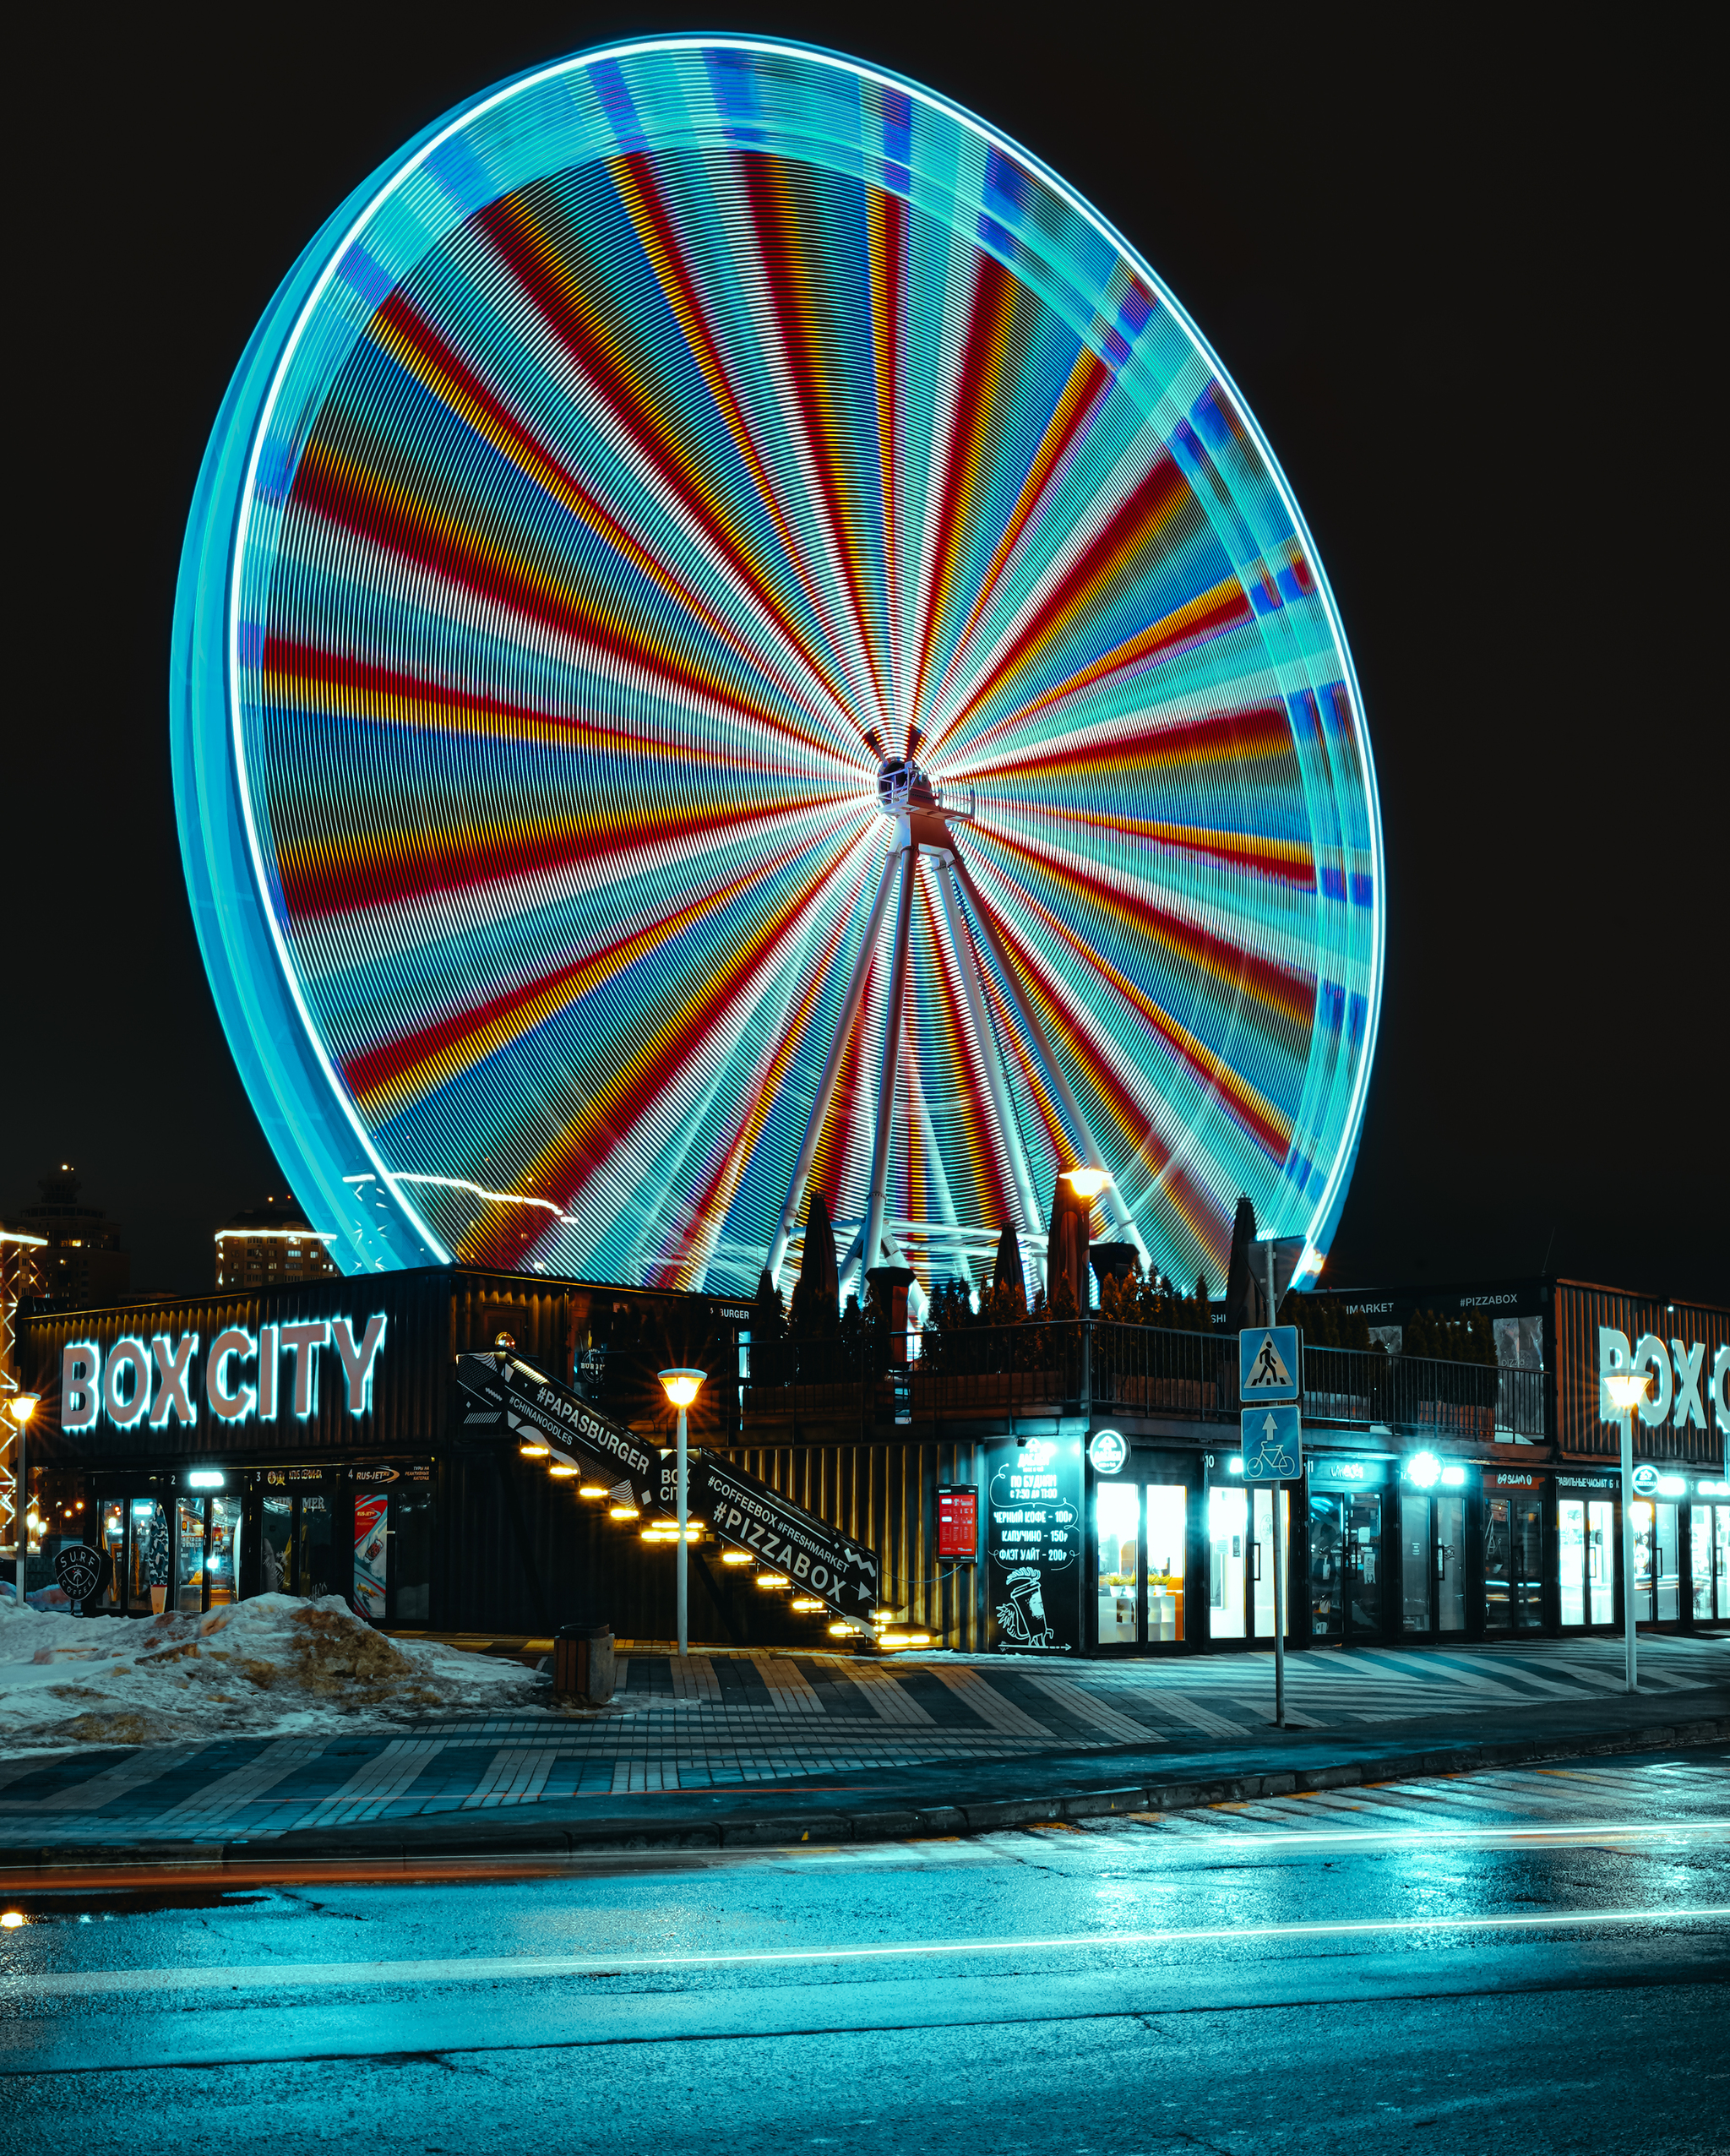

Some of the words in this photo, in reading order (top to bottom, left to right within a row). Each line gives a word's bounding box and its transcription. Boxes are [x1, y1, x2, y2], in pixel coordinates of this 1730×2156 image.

[1461, 1294, 1517, 1307] #PIZZABOX
[1346, 1303, 1394, 1315] MARKET
[63, 1335, 198, 1429] BOX
[206, 1315, 387, 1421] CITY
[509, 1395, 574, 1446] #CHINANOODLES
[537, 1386, 650, 1474] #PAPASBURGER
[1205, 1455, 1215, 1467] 10
[1308, 1461, 1314, 1473] 11
[171, 1475, 176, 1485] 2
[256, 1472, 261, 1482] 3
[348, 1469, 354, 1479] 4
[1010, 1475, 1023, 1488] ПО
[1023, 1474, 1057, 1489] БУДНЯМ
[1015, 1489, 1030, 1499] 7:30
[1041, 1489, 1058, 1499] 11:00
[993, 1510, 1024, 1523] ЧЕРНЫЙ
[1025, 1511, 1047, 1523] КОФЕ
[708, 1475, 778, 1527] #COFFEEBOX
[777, 1521, 850, 1573] #FRESHMARKET
[1002, 1530, 1042, 1542] КАПУЧИНО
[714, 1501, 847, 1604] #PIZZABOX
[999, 1549, 1019, 1561] ФЛЭТ
[1020, 1547, 1040, 1560] УАЙТ
[60, 1551, 95, 1568] SURF
[62, 1579, 92, 1597] COFFEE
